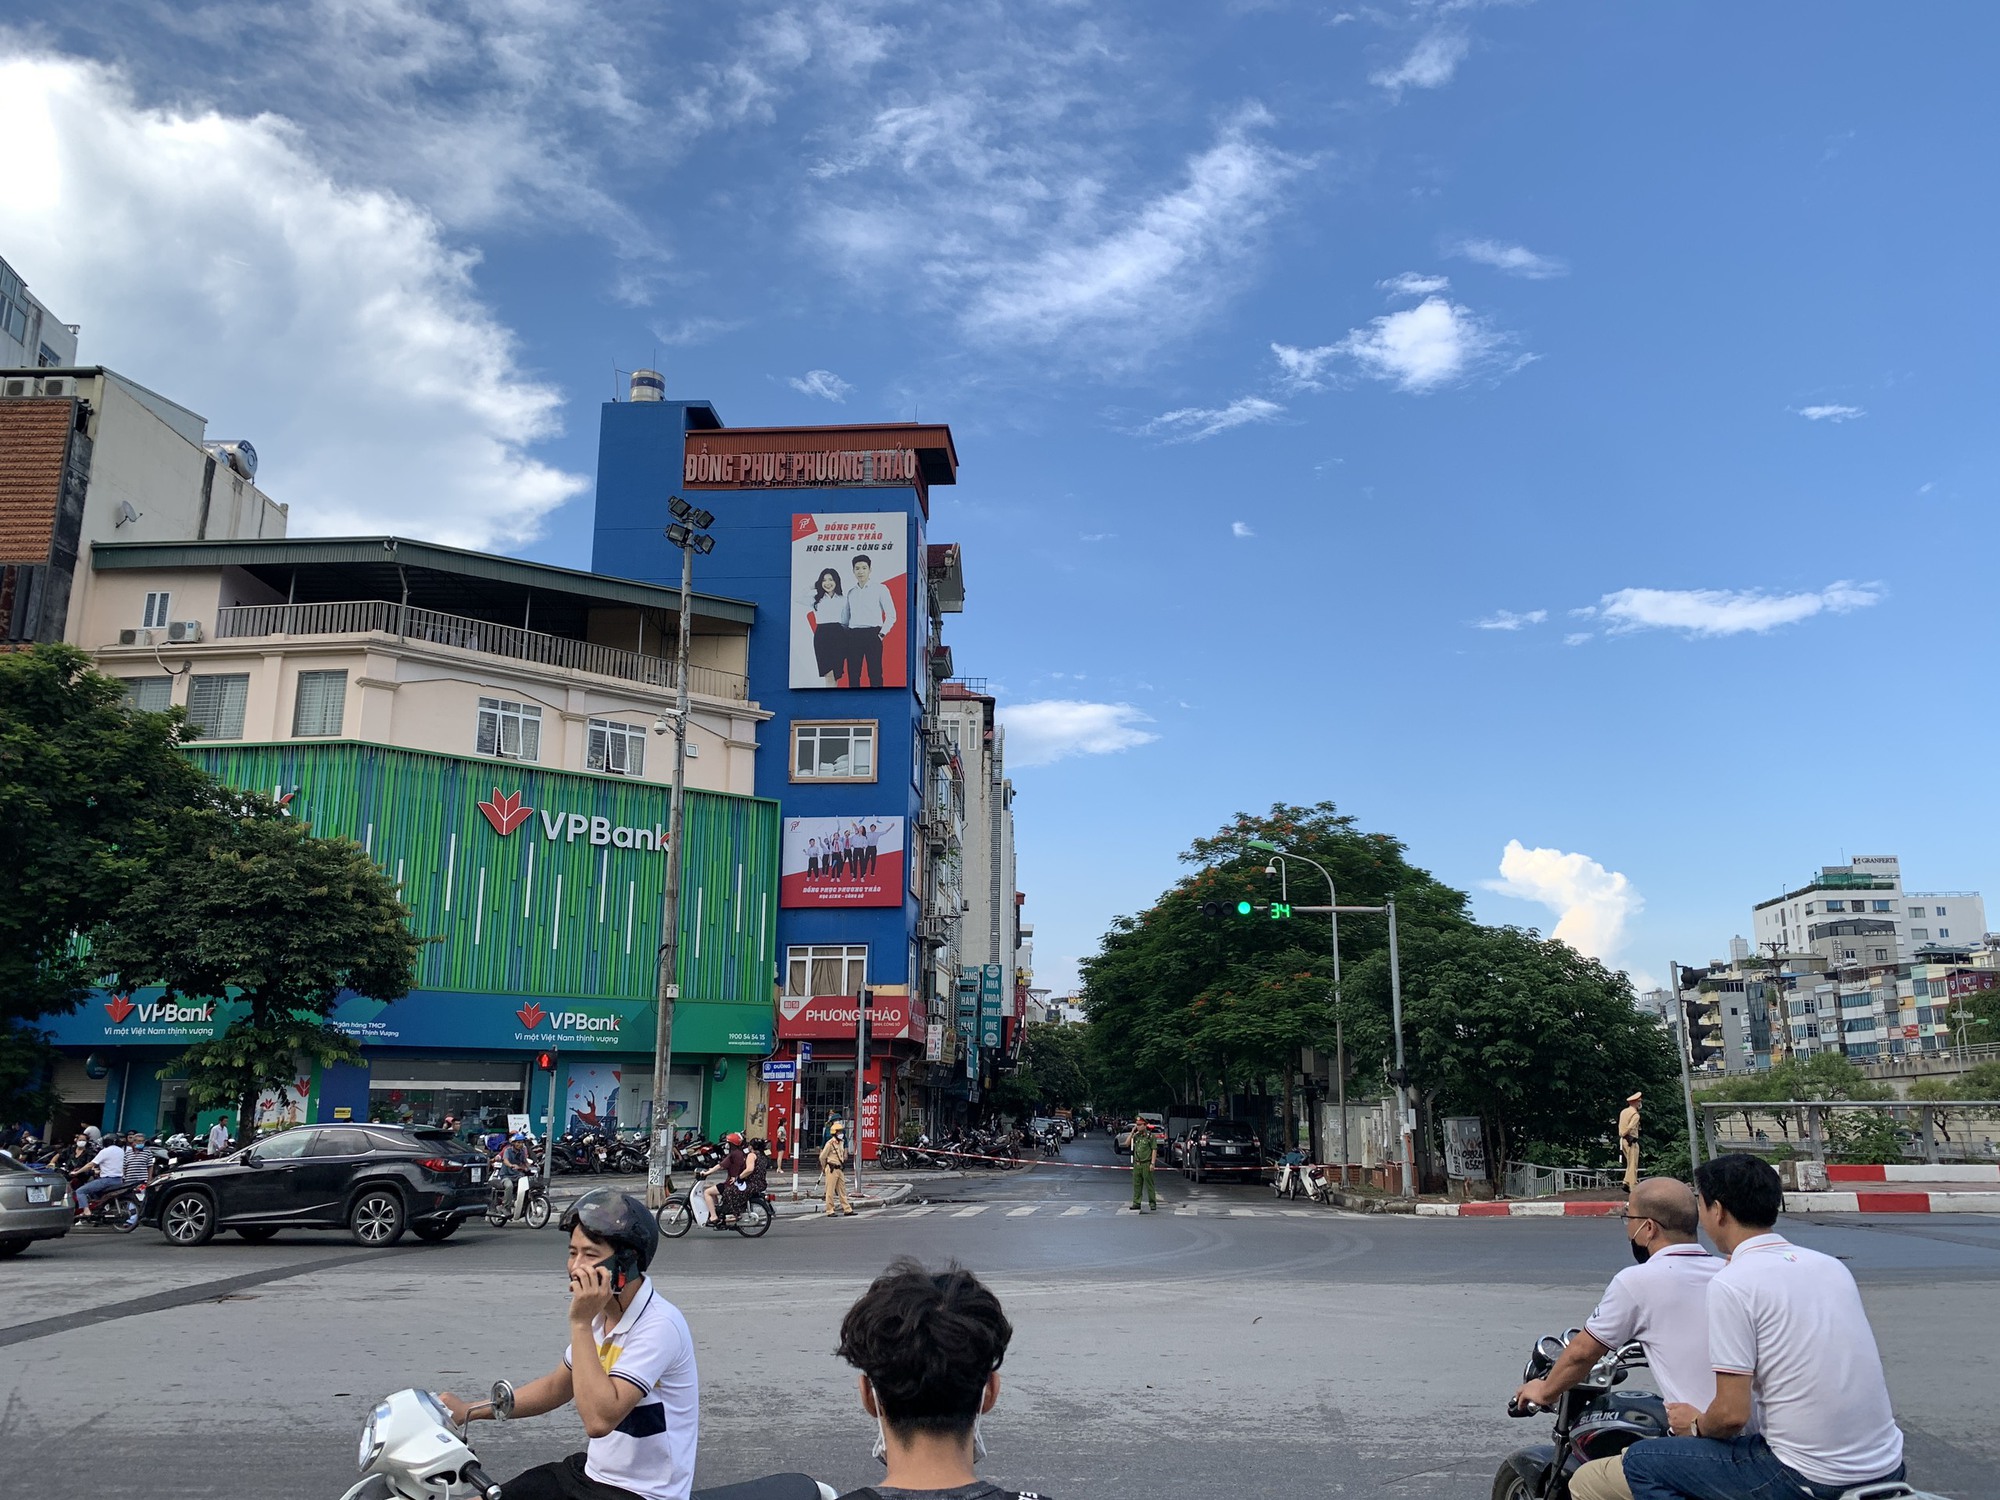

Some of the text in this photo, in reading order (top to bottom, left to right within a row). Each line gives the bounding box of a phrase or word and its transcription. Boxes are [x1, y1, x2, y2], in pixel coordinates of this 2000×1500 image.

[685, 442, 915, 486] ĐỒNG PHỤC PHƯƠNG THẢO
[851, 523, 876, 532] PHỤC
[806, 545, 824, 554] HỌC
[541, 809, 669, 852] VPBank
[1271, 903, 1289, 919] 34
[986, 980, 999, 990] NHA
[983, 993, 1000, 1003] KHOA
[137, 1003, 215, 1022] VPBank
[806, 1008, 860, 1021] PHƯƠNG
[864, 1006, 901, 1021] THẢO
[982, 1007, 1001, 1017] SMILE
[351, 1021, 367, 1029] hàng
[549, 1011, 620, 1031] VPBank
[985, 1021, 998, 1031] ONE
[114, 1028, 129, 1036] một
[130, 1027, 146, 1036] Việt
[167, 1027, 187, 1036] thịnh
[188, 1028, 214, 1036] vượng
[524, 1034, 539, 1042] một
[541, 1033, 556, 1042] Việt
[576, 1034, 595, 1043] thịnh
[596, 1036, 619, 1044] vượng
[776, 1081, 785, 1092] 2
[1209, 1104, 1216, 1114] P
[1579, 1411, 1620, 1425] SUZUKI
